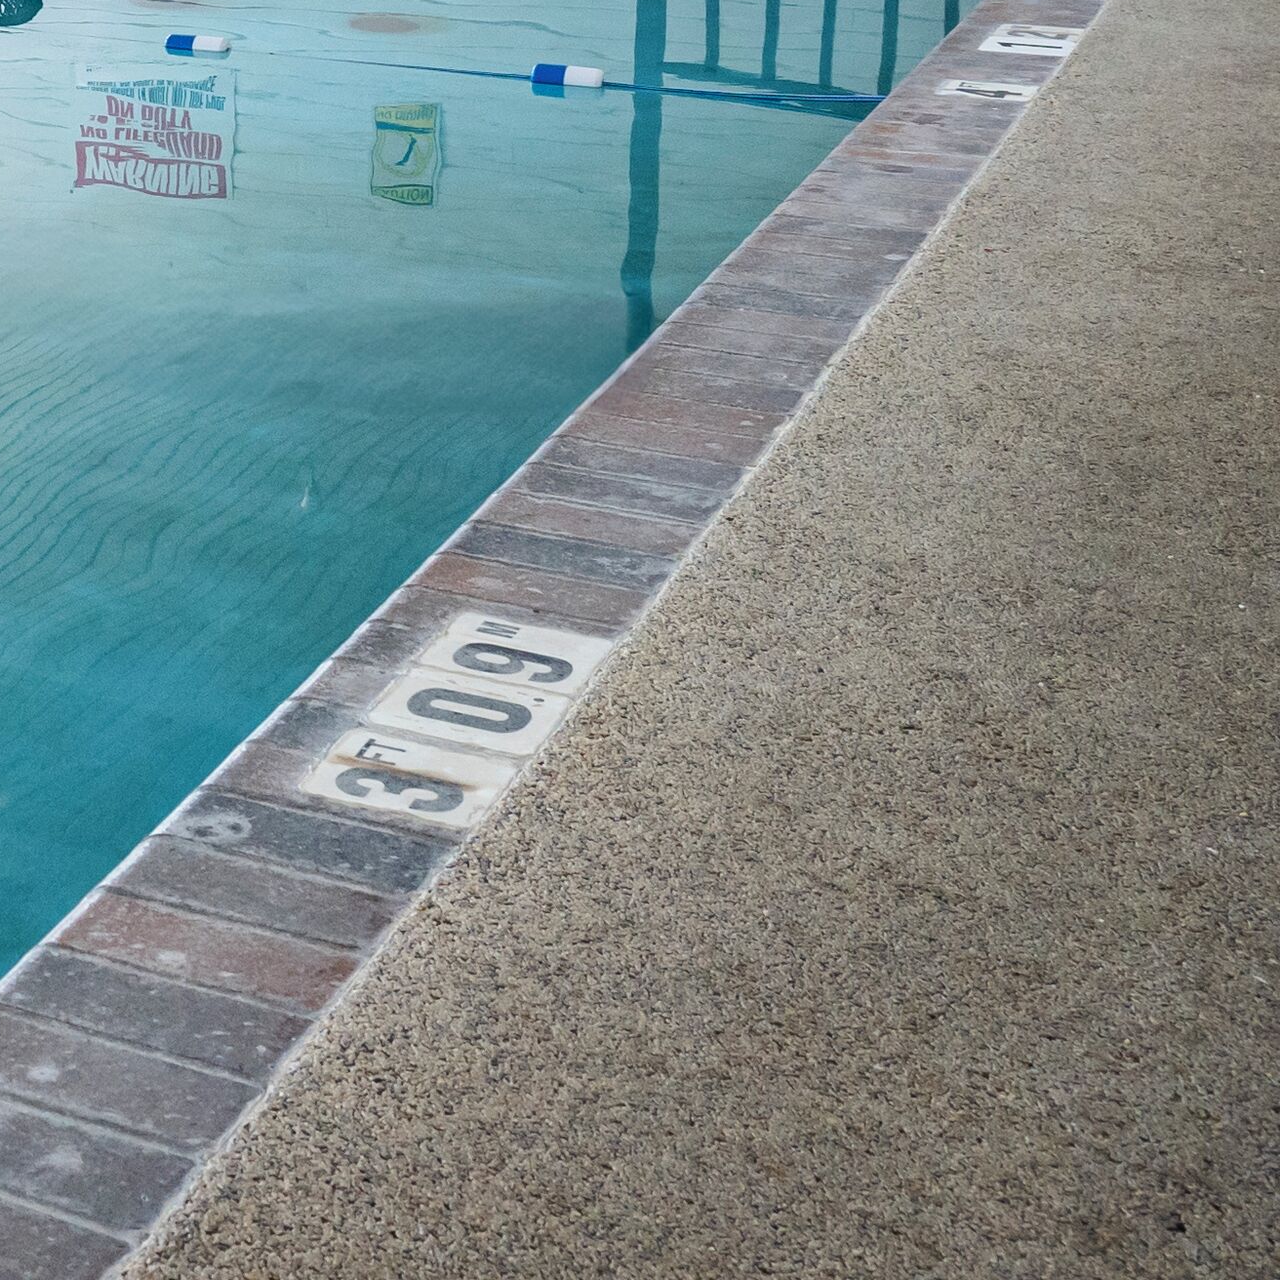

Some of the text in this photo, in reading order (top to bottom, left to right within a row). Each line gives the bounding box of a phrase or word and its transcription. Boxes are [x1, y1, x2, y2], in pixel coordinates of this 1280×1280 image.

[955, 87, 1023, 99] 4
[475, 621, 520, 639] M
[355, 738, 405, 765] FT
[335, 766, 464, 812] 3
